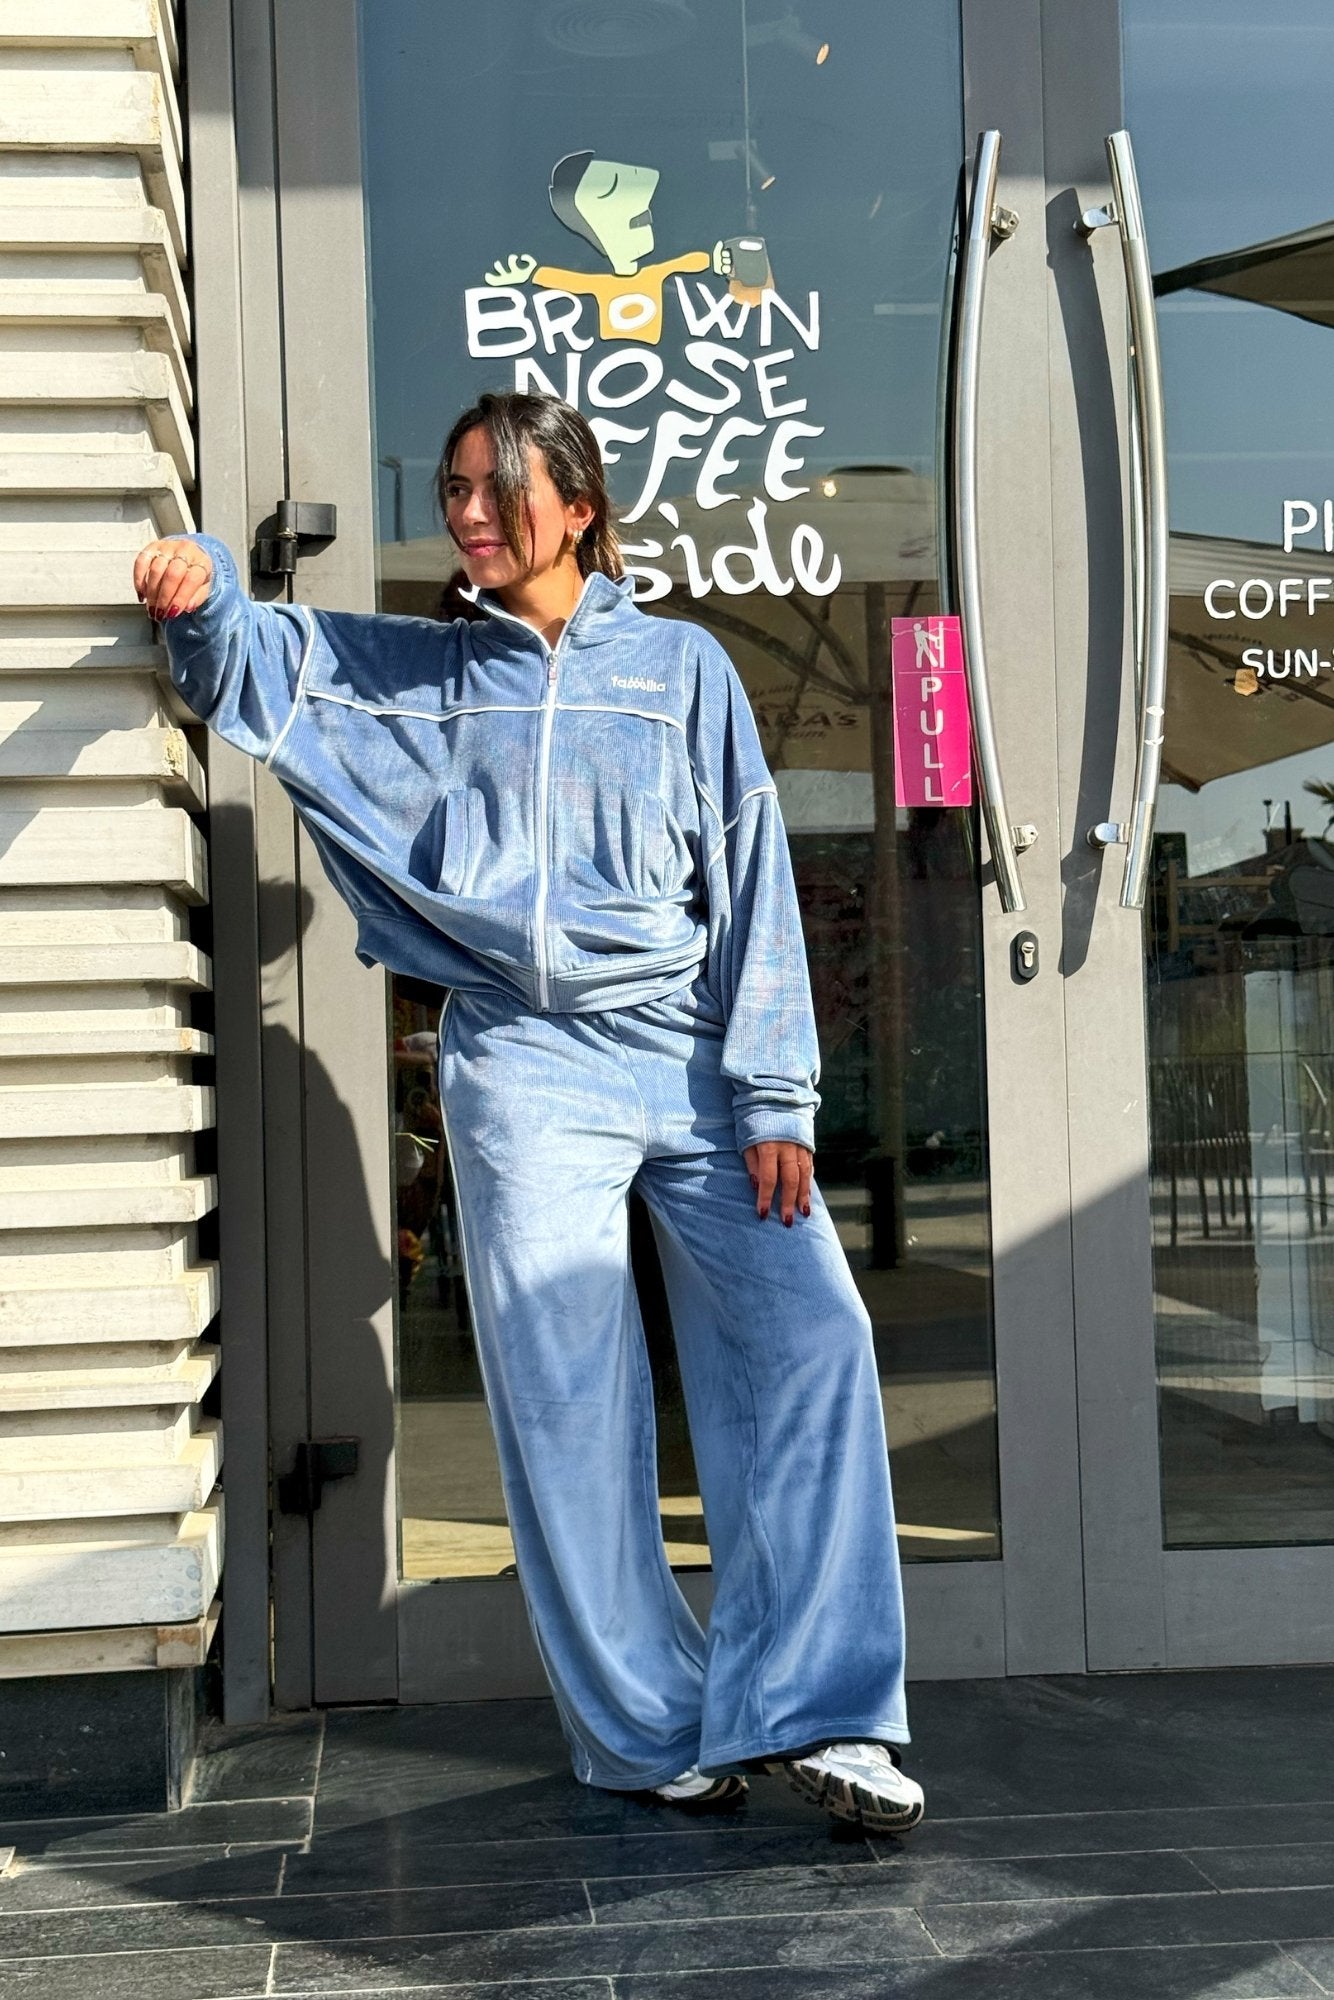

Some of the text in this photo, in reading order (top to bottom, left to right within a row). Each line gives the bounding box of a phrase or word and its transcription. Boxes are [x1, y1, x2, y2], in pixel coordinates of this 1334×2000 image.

[464, 276, 820, 358] BROWN
[514, 341, 808, 419] NOSE
[587, 410, 825, 524] FFEE
[1241, 648, 1334, 679] SUN-
[920, 676, 945, 802] PULL
